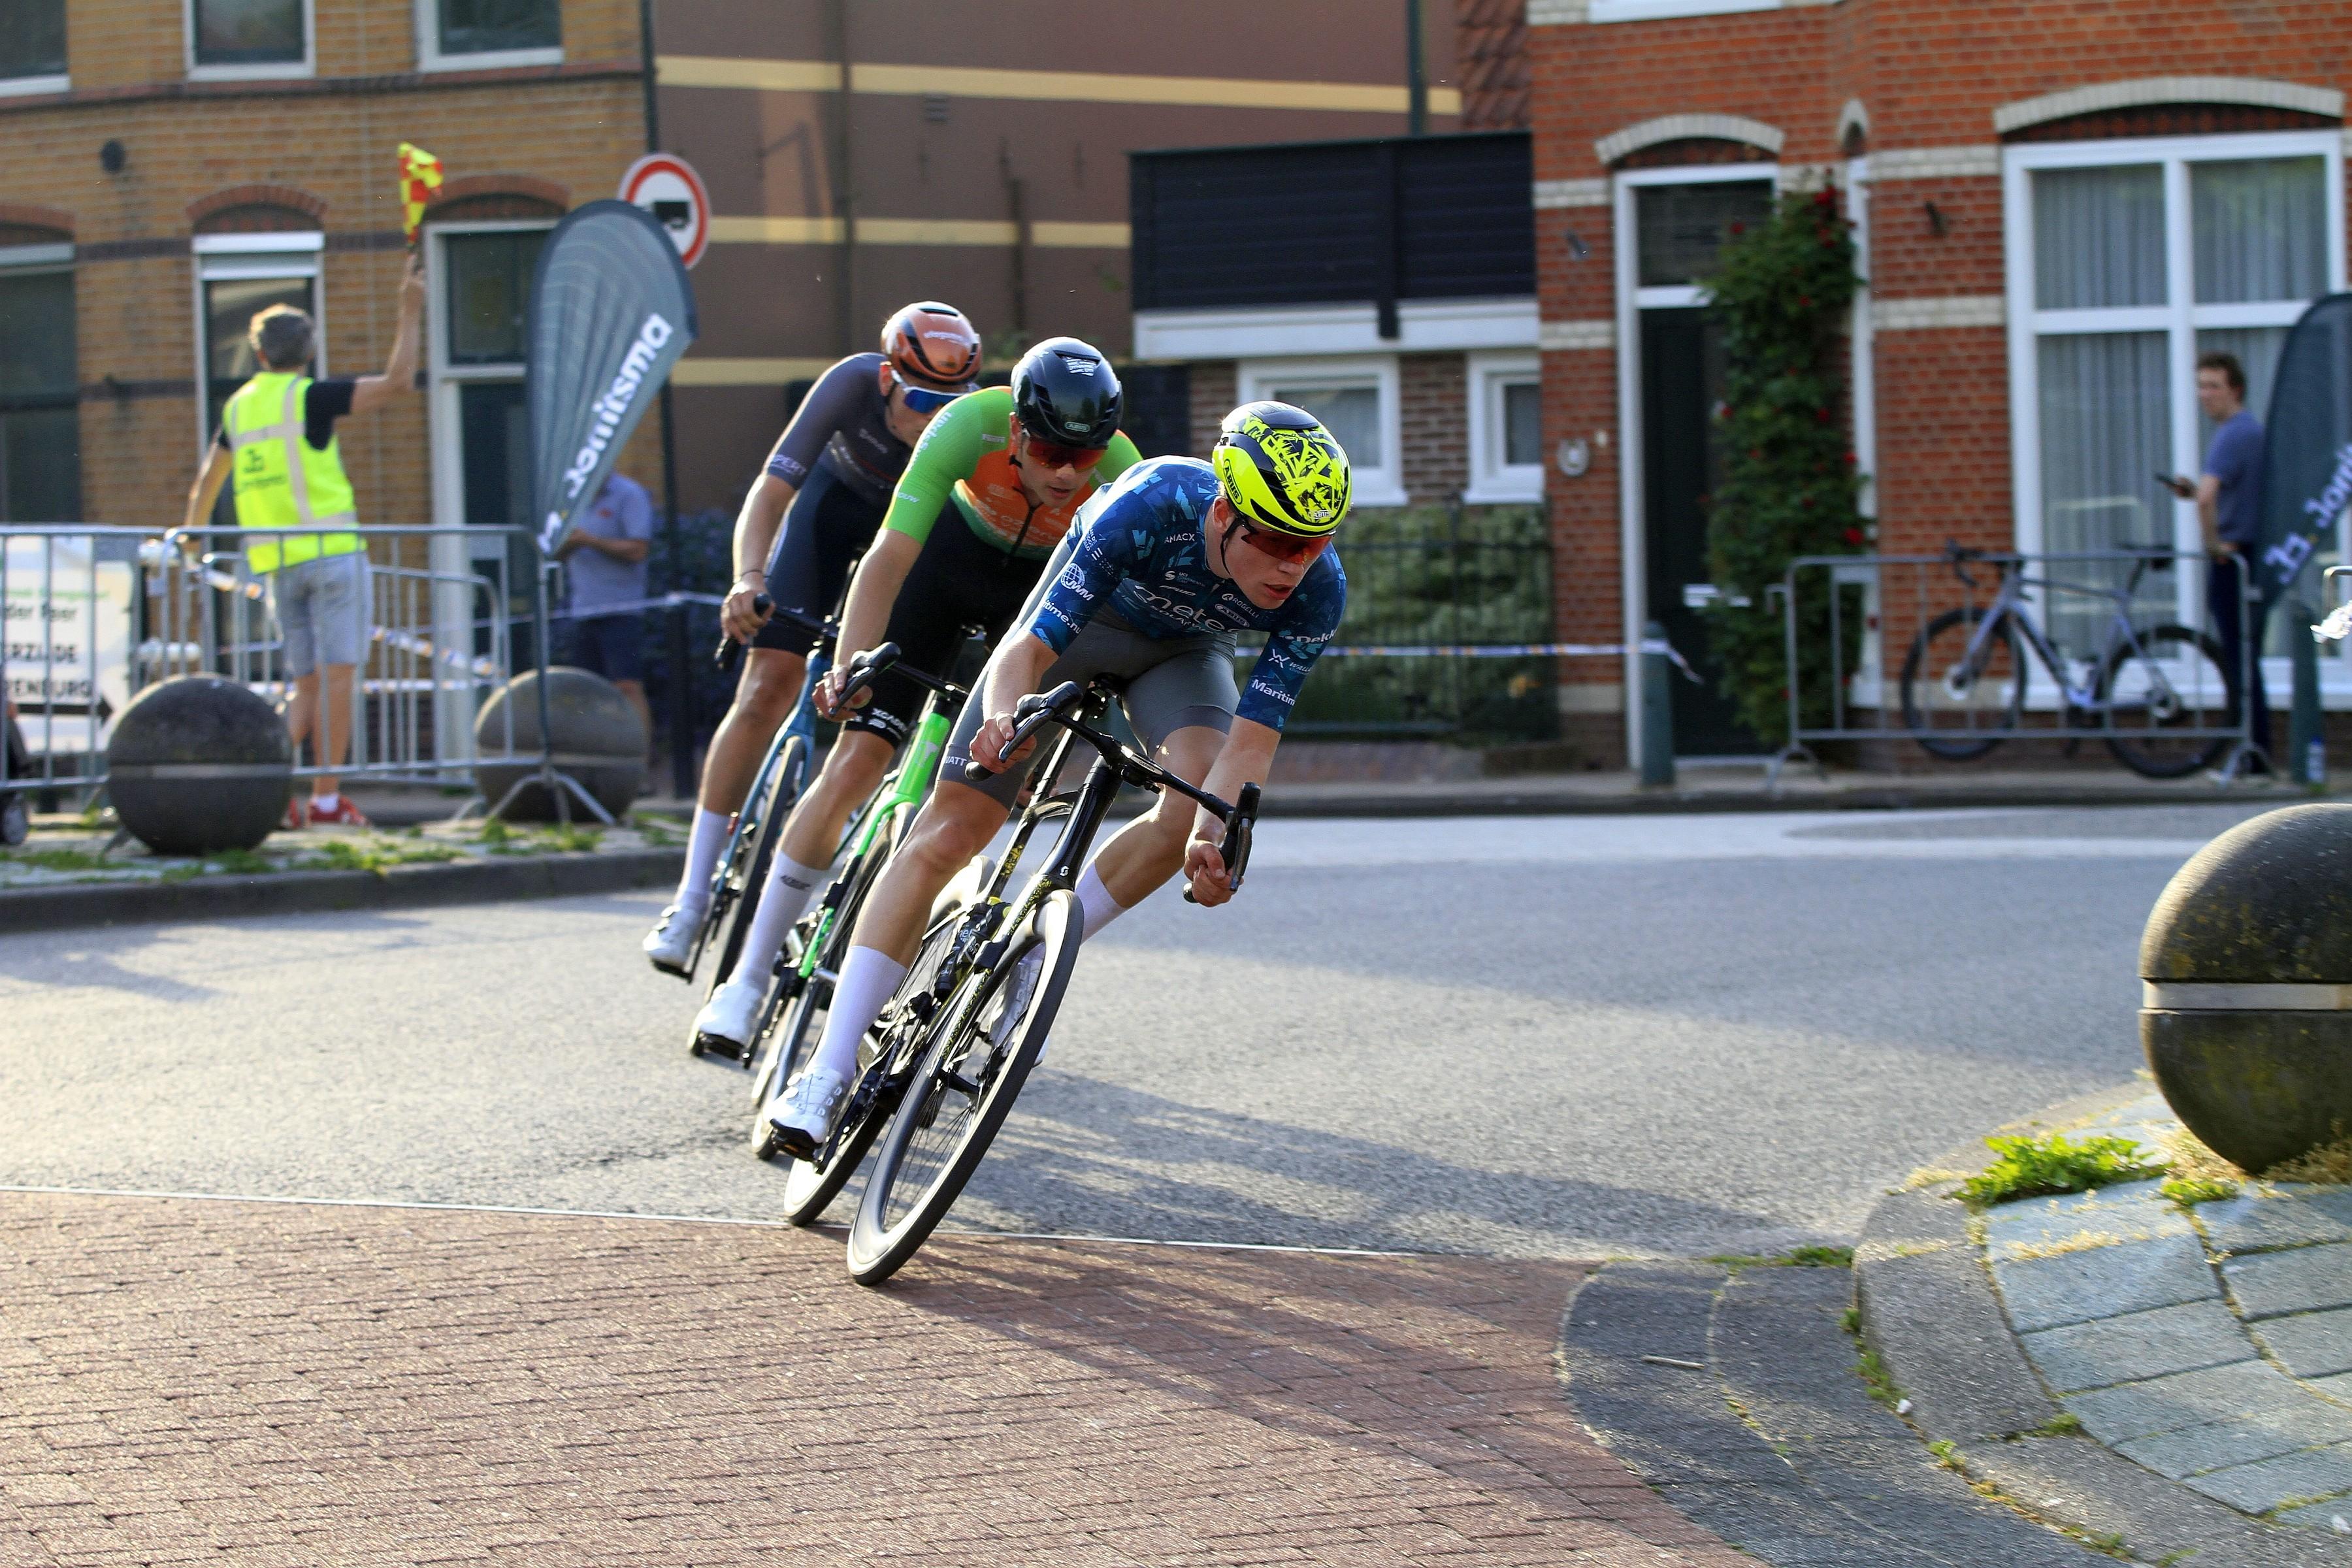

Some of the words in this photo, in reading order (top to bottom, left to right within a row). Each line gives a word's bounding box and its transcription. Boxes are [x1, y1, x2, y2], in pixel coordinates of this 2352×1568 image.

[1223, 466, 1239, 501] ABUS
[1065, 580, 1095, 602] JWM
[1232, 597, 1260, 619] ROGELLI
